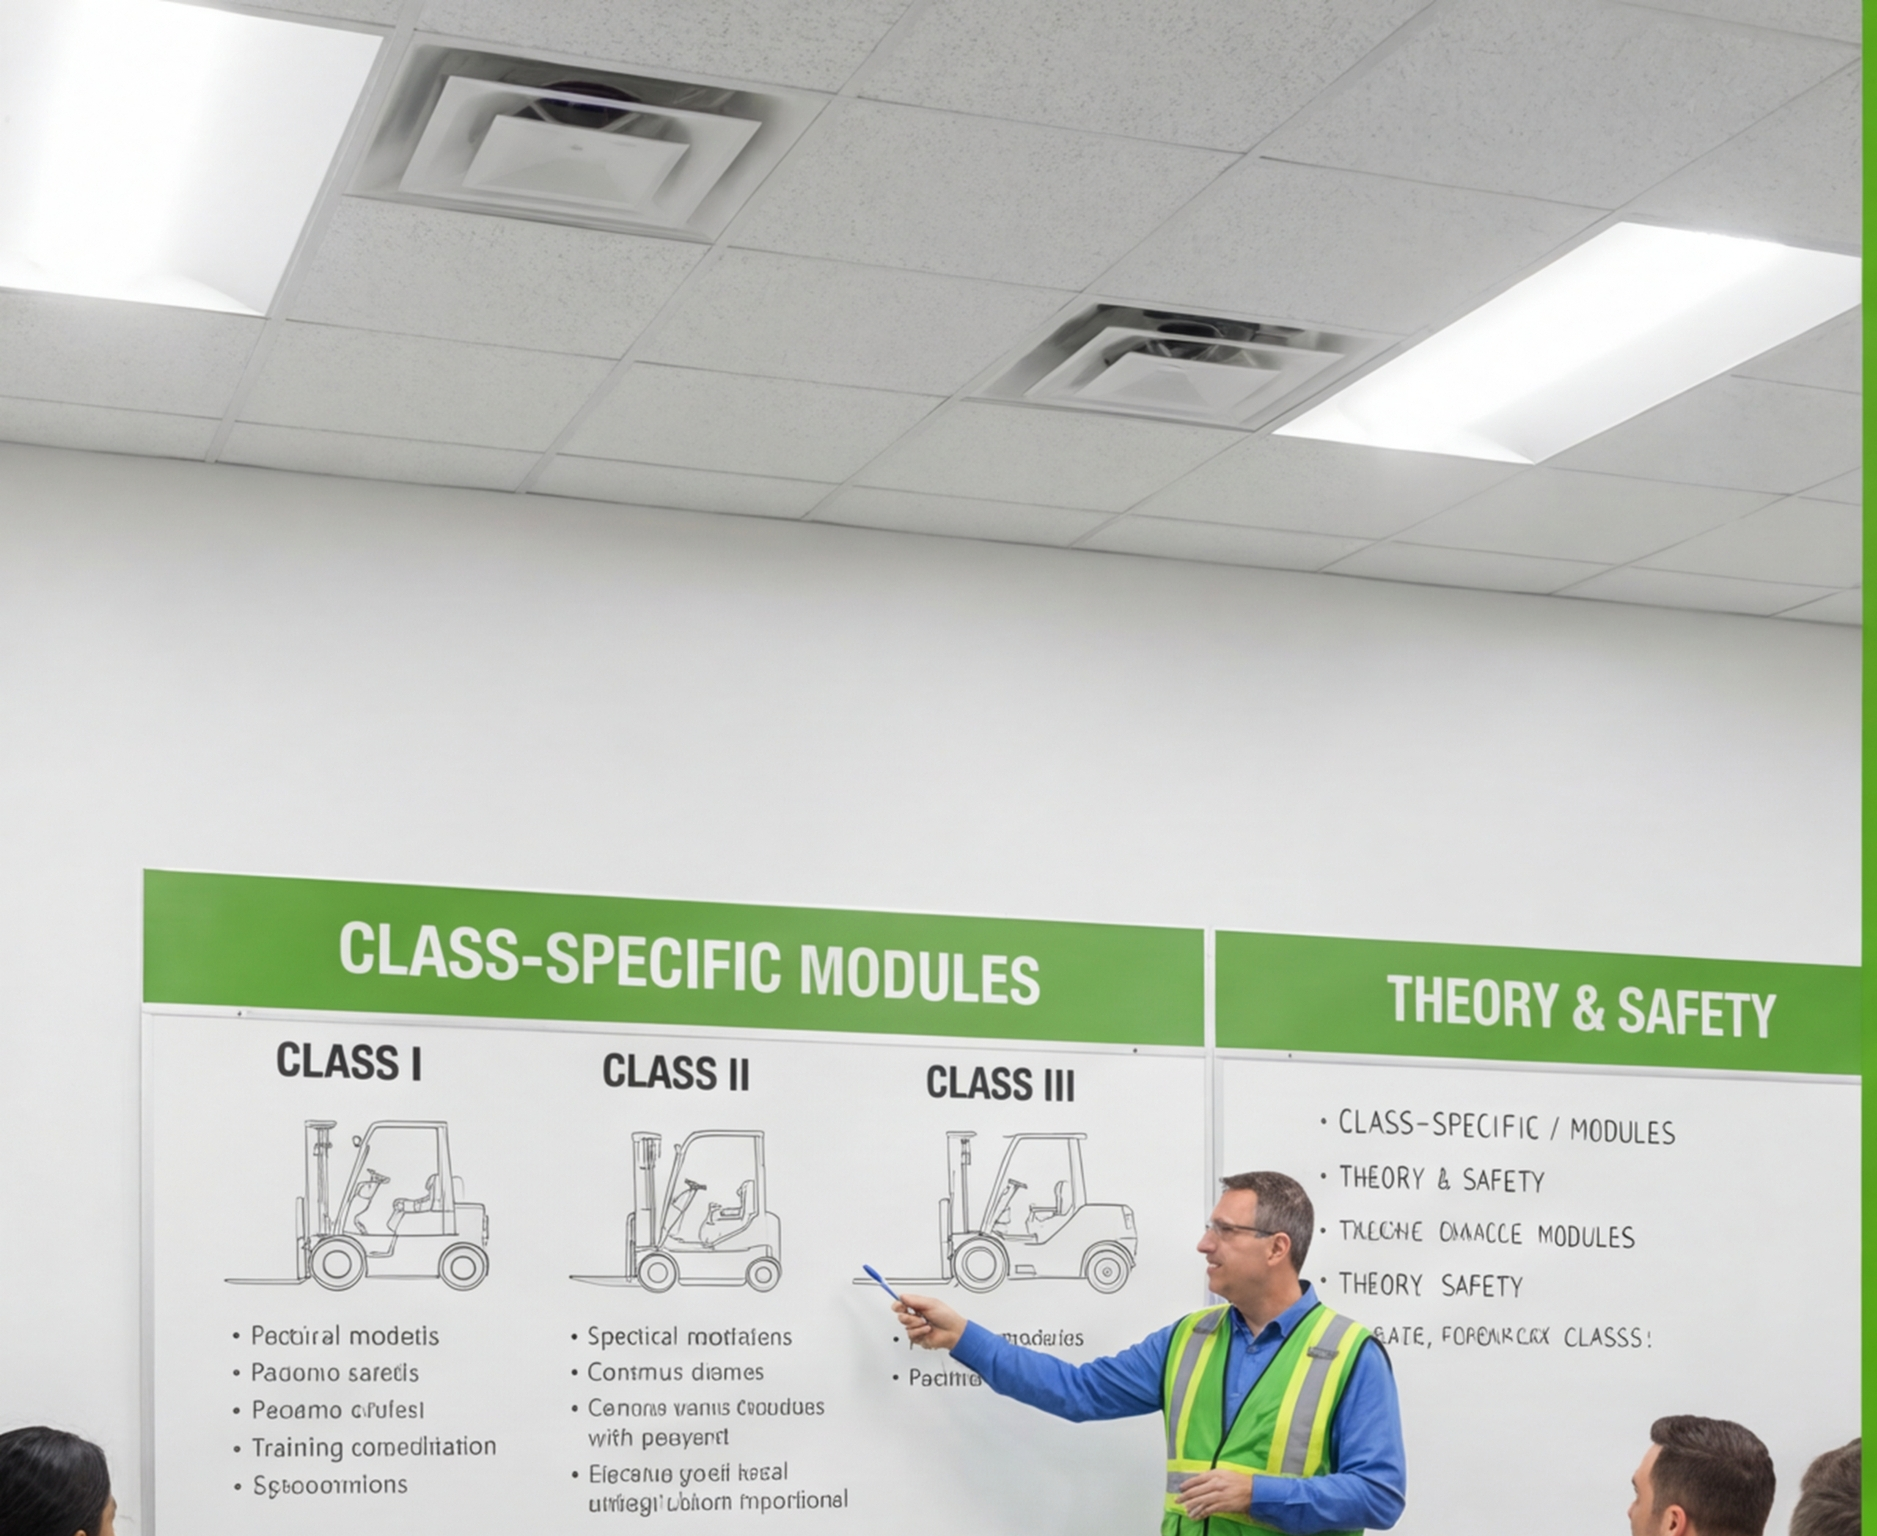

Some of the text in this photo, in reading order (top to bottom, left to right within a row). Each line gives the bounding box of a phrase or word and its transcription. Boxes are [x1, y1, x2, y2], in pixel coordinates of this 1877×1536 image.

[339, 920, 1041, 1006] CLASS-SPECIFIC MODULES
[1386, 974, 1777, 1039] THEORY & SAFETY
[276, 1040, 421, 1082] CLASS I
[603, 1052, 749, 1092] CLASS II
[926, 1064, 1075, 1103] CLASS III
[1339, 1107, 1539, 1141] CLASS-SPECIFIC
[1570, 1117, 1676, 1146] MODULES
[1339, 1164, 1425, 1190] THEORY
[1463, 1167, 1545, 1194] SAFETY
[1538, 1224, 1636, 1250] MODULES
[1338, 1271, 1523, 1298] THEORY SAFETY
[251, 1436, 343, 1463] Training
